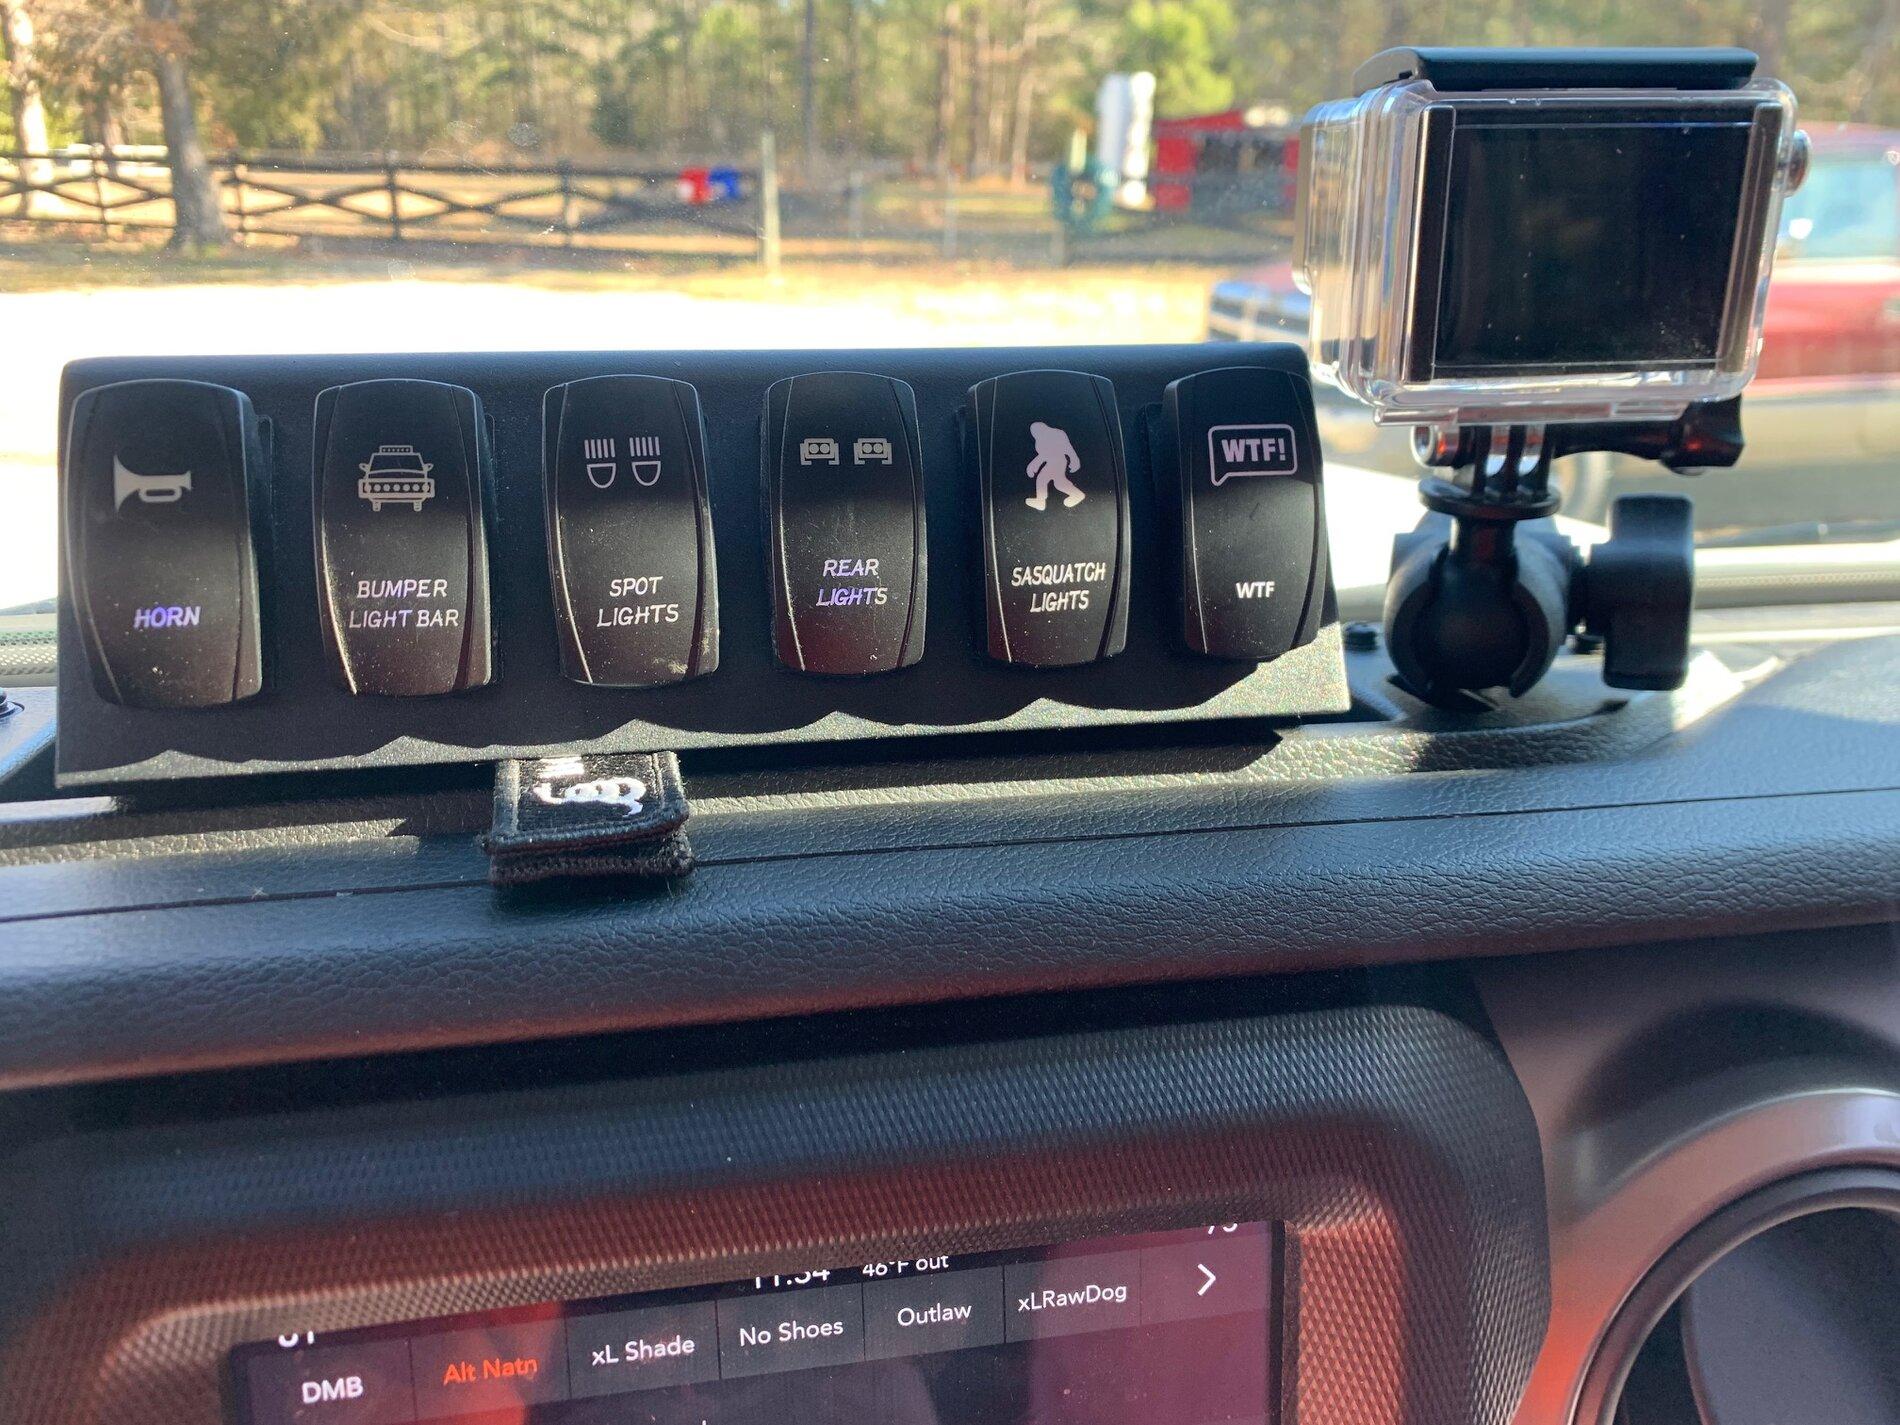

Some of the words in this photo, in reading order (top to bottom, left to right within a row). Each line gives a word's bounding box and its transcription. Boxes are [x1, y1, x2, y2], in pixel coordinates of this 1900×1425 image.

[1221, 437, 1286, 463] WTF!
[822, 558, 880, 577] REAR
[1011, 561, 1106, 587] SASQUATCH
[356, 578, 448, 599] BUMPER
[609, 575, 664, 597] SPOT
[815, 586, 889, 608] LIGHTS
[1235, 580, 1275, 599] WTF
[1029, 589, 1090, 613] LIGHTS
[134, 605, 201, 628] HORN
[348, 608, 414, 629] LIGHT
[415, 608, 459, 628] BAR
[596, 603, 679, 628] LIGHTS
[915, 1255, 949, 1271] out
[1017, 1284, 1127, 1312] xLRawDog
[897, 1302, 972, 1327] Outlaw
[739, 1326, 772, 1347] No
[778, 1320, 844, 1342] Shoes
[592, 1344, 620, 1366] xL
[625, 1334, 696, 1361] Shade
[443, 1361, 477, 1385] Alt
[482, 1356, 538, 1380] Natn
[301, 1375, 364, 1404] DMB
